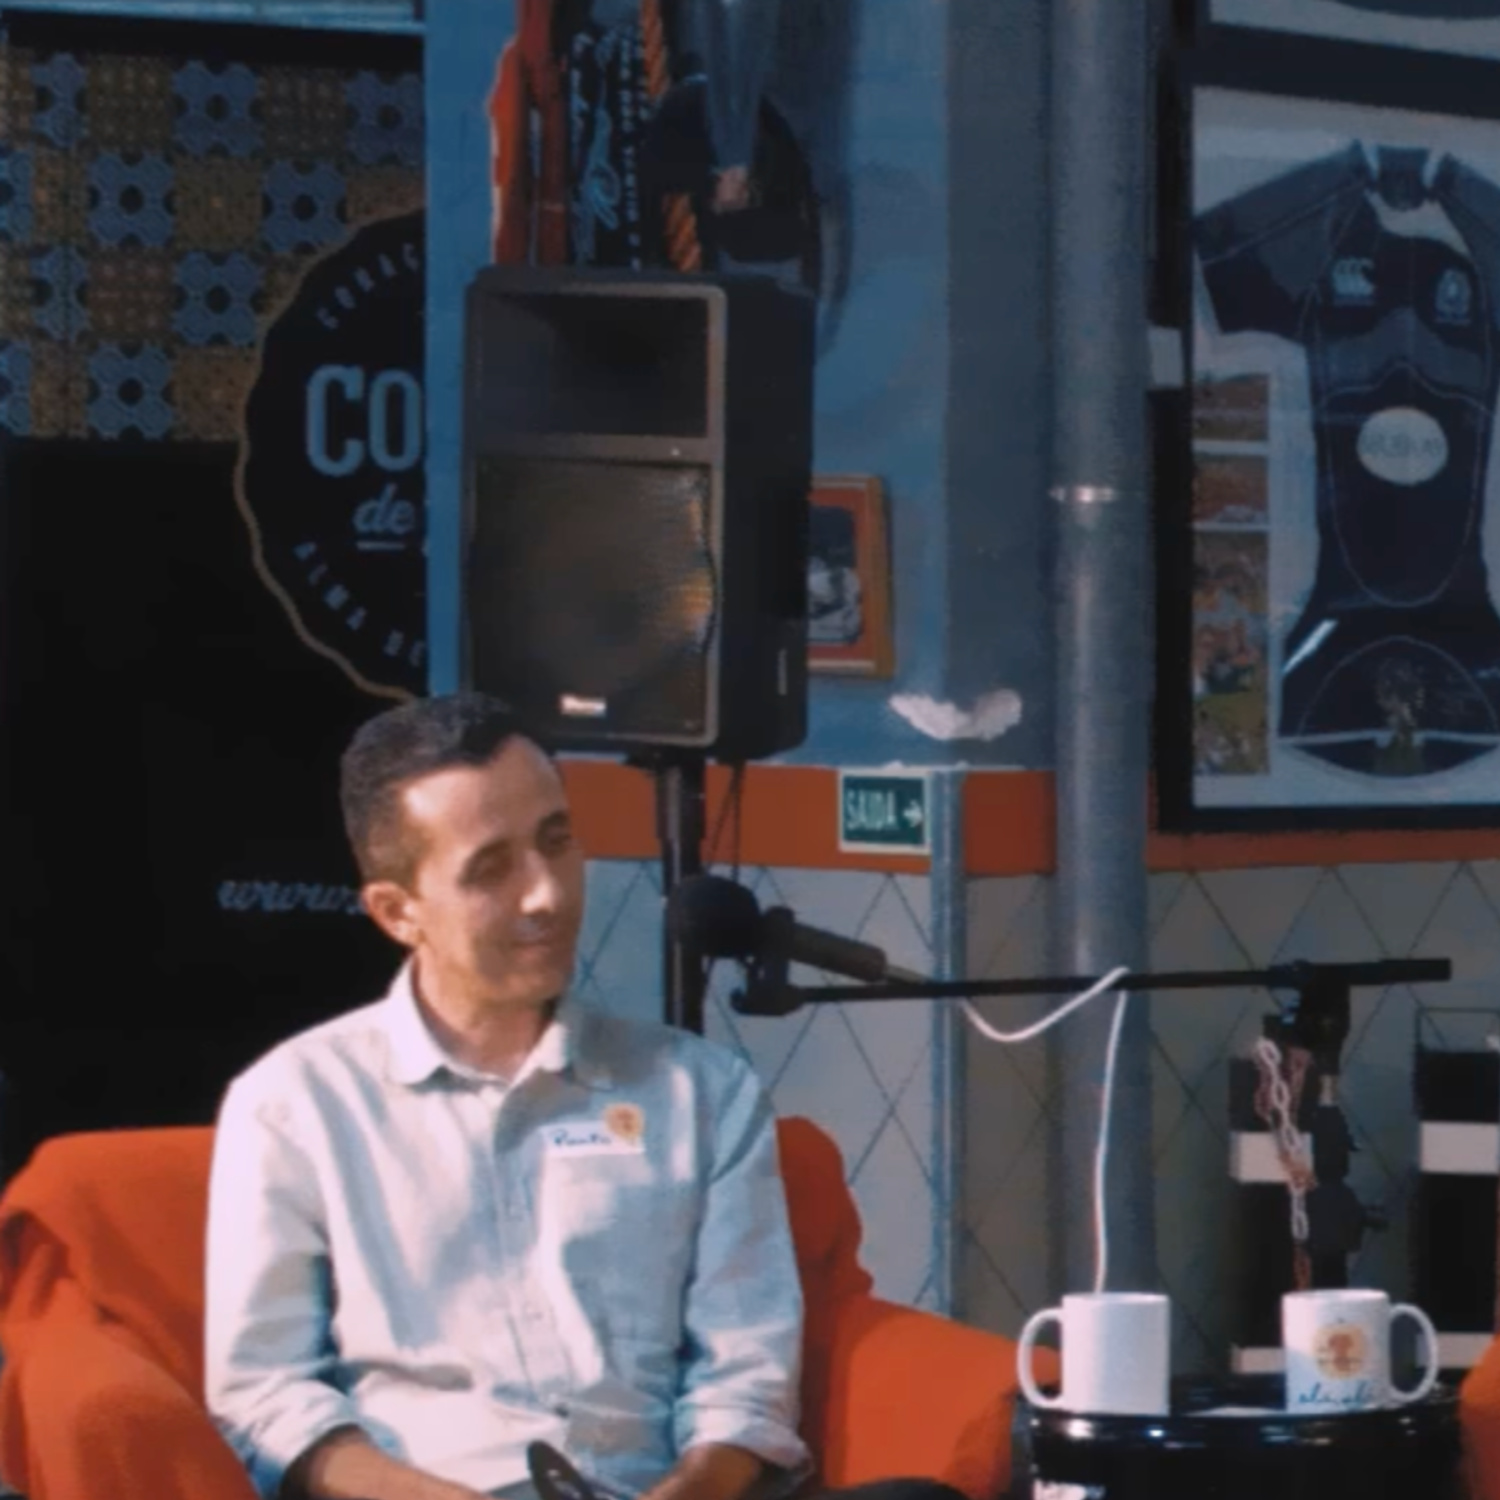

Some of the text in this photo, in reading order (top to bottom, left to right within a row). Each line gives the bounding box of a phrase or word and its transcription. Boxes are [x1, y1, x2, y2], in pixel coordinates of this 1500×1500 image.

[306, 364, 423, 476] CO
[352, 482, 416, 534] de
[216, 880, 368, 915] www.
